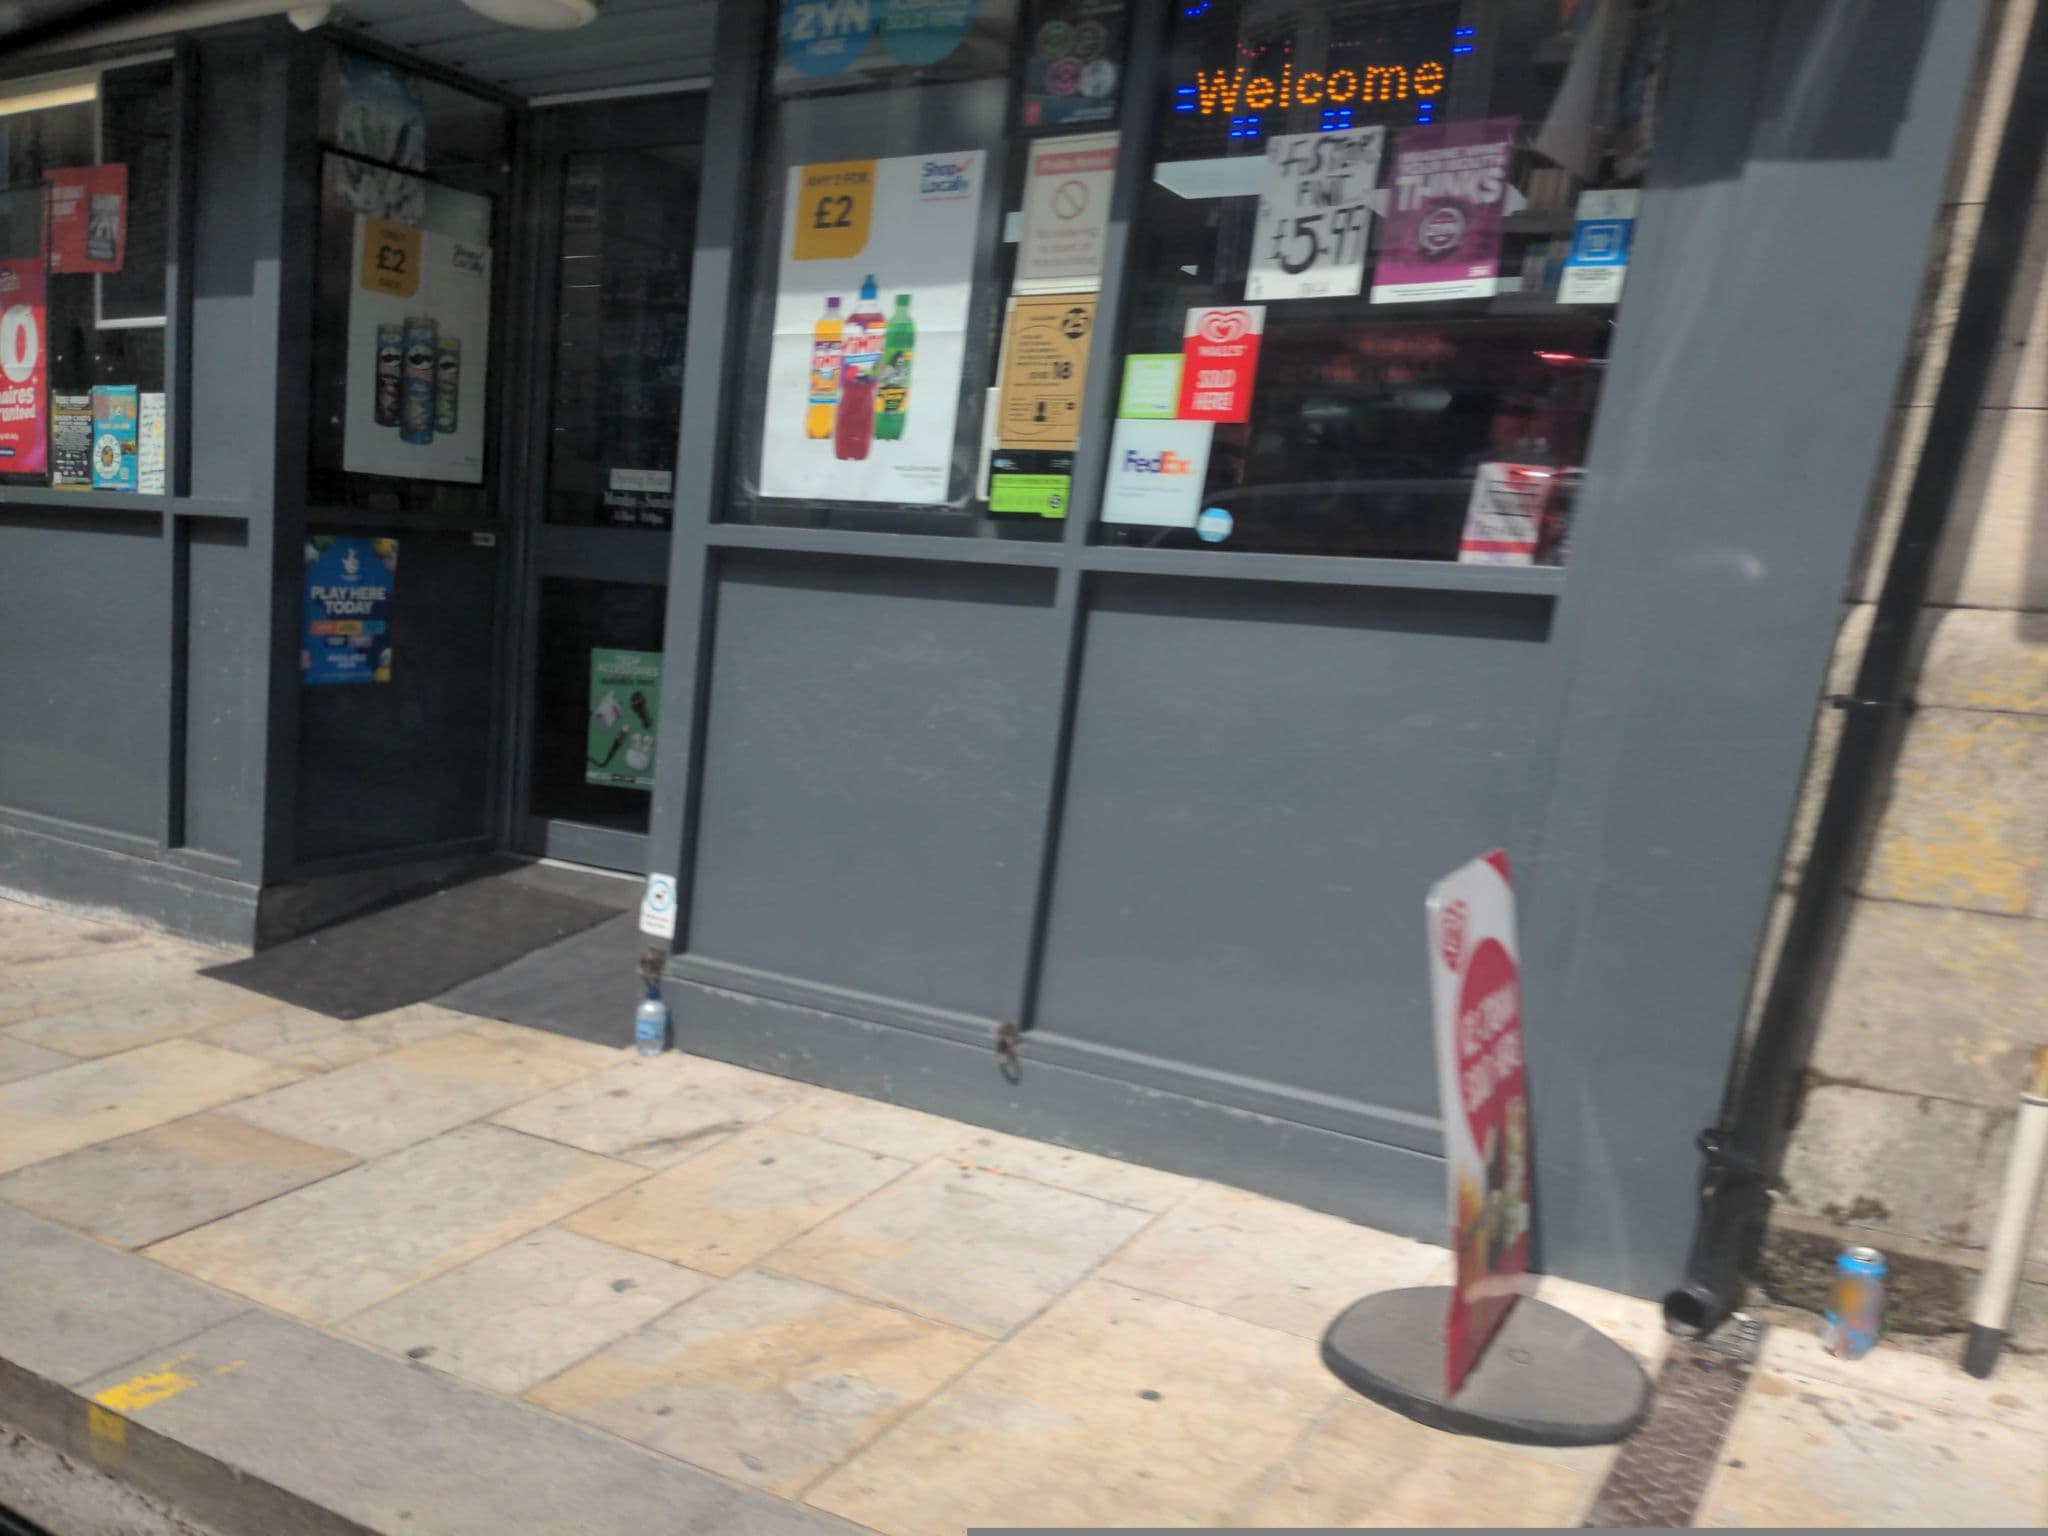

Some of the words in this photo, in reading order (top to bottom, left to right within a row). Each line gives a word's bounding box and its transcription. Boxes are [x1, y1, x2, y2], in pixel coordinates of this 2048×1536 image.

[1196, 60, 1445, 115] Welcome
[813, 194, 853, 229] £2
[376, 244, 407, 274] £2
[1123, 449, 1194, 475] FedEx
[310, 585, 348, 600] PLAY
[350, 586, 387, 601] HERE
[323, 600, 374, 615] TODAY
